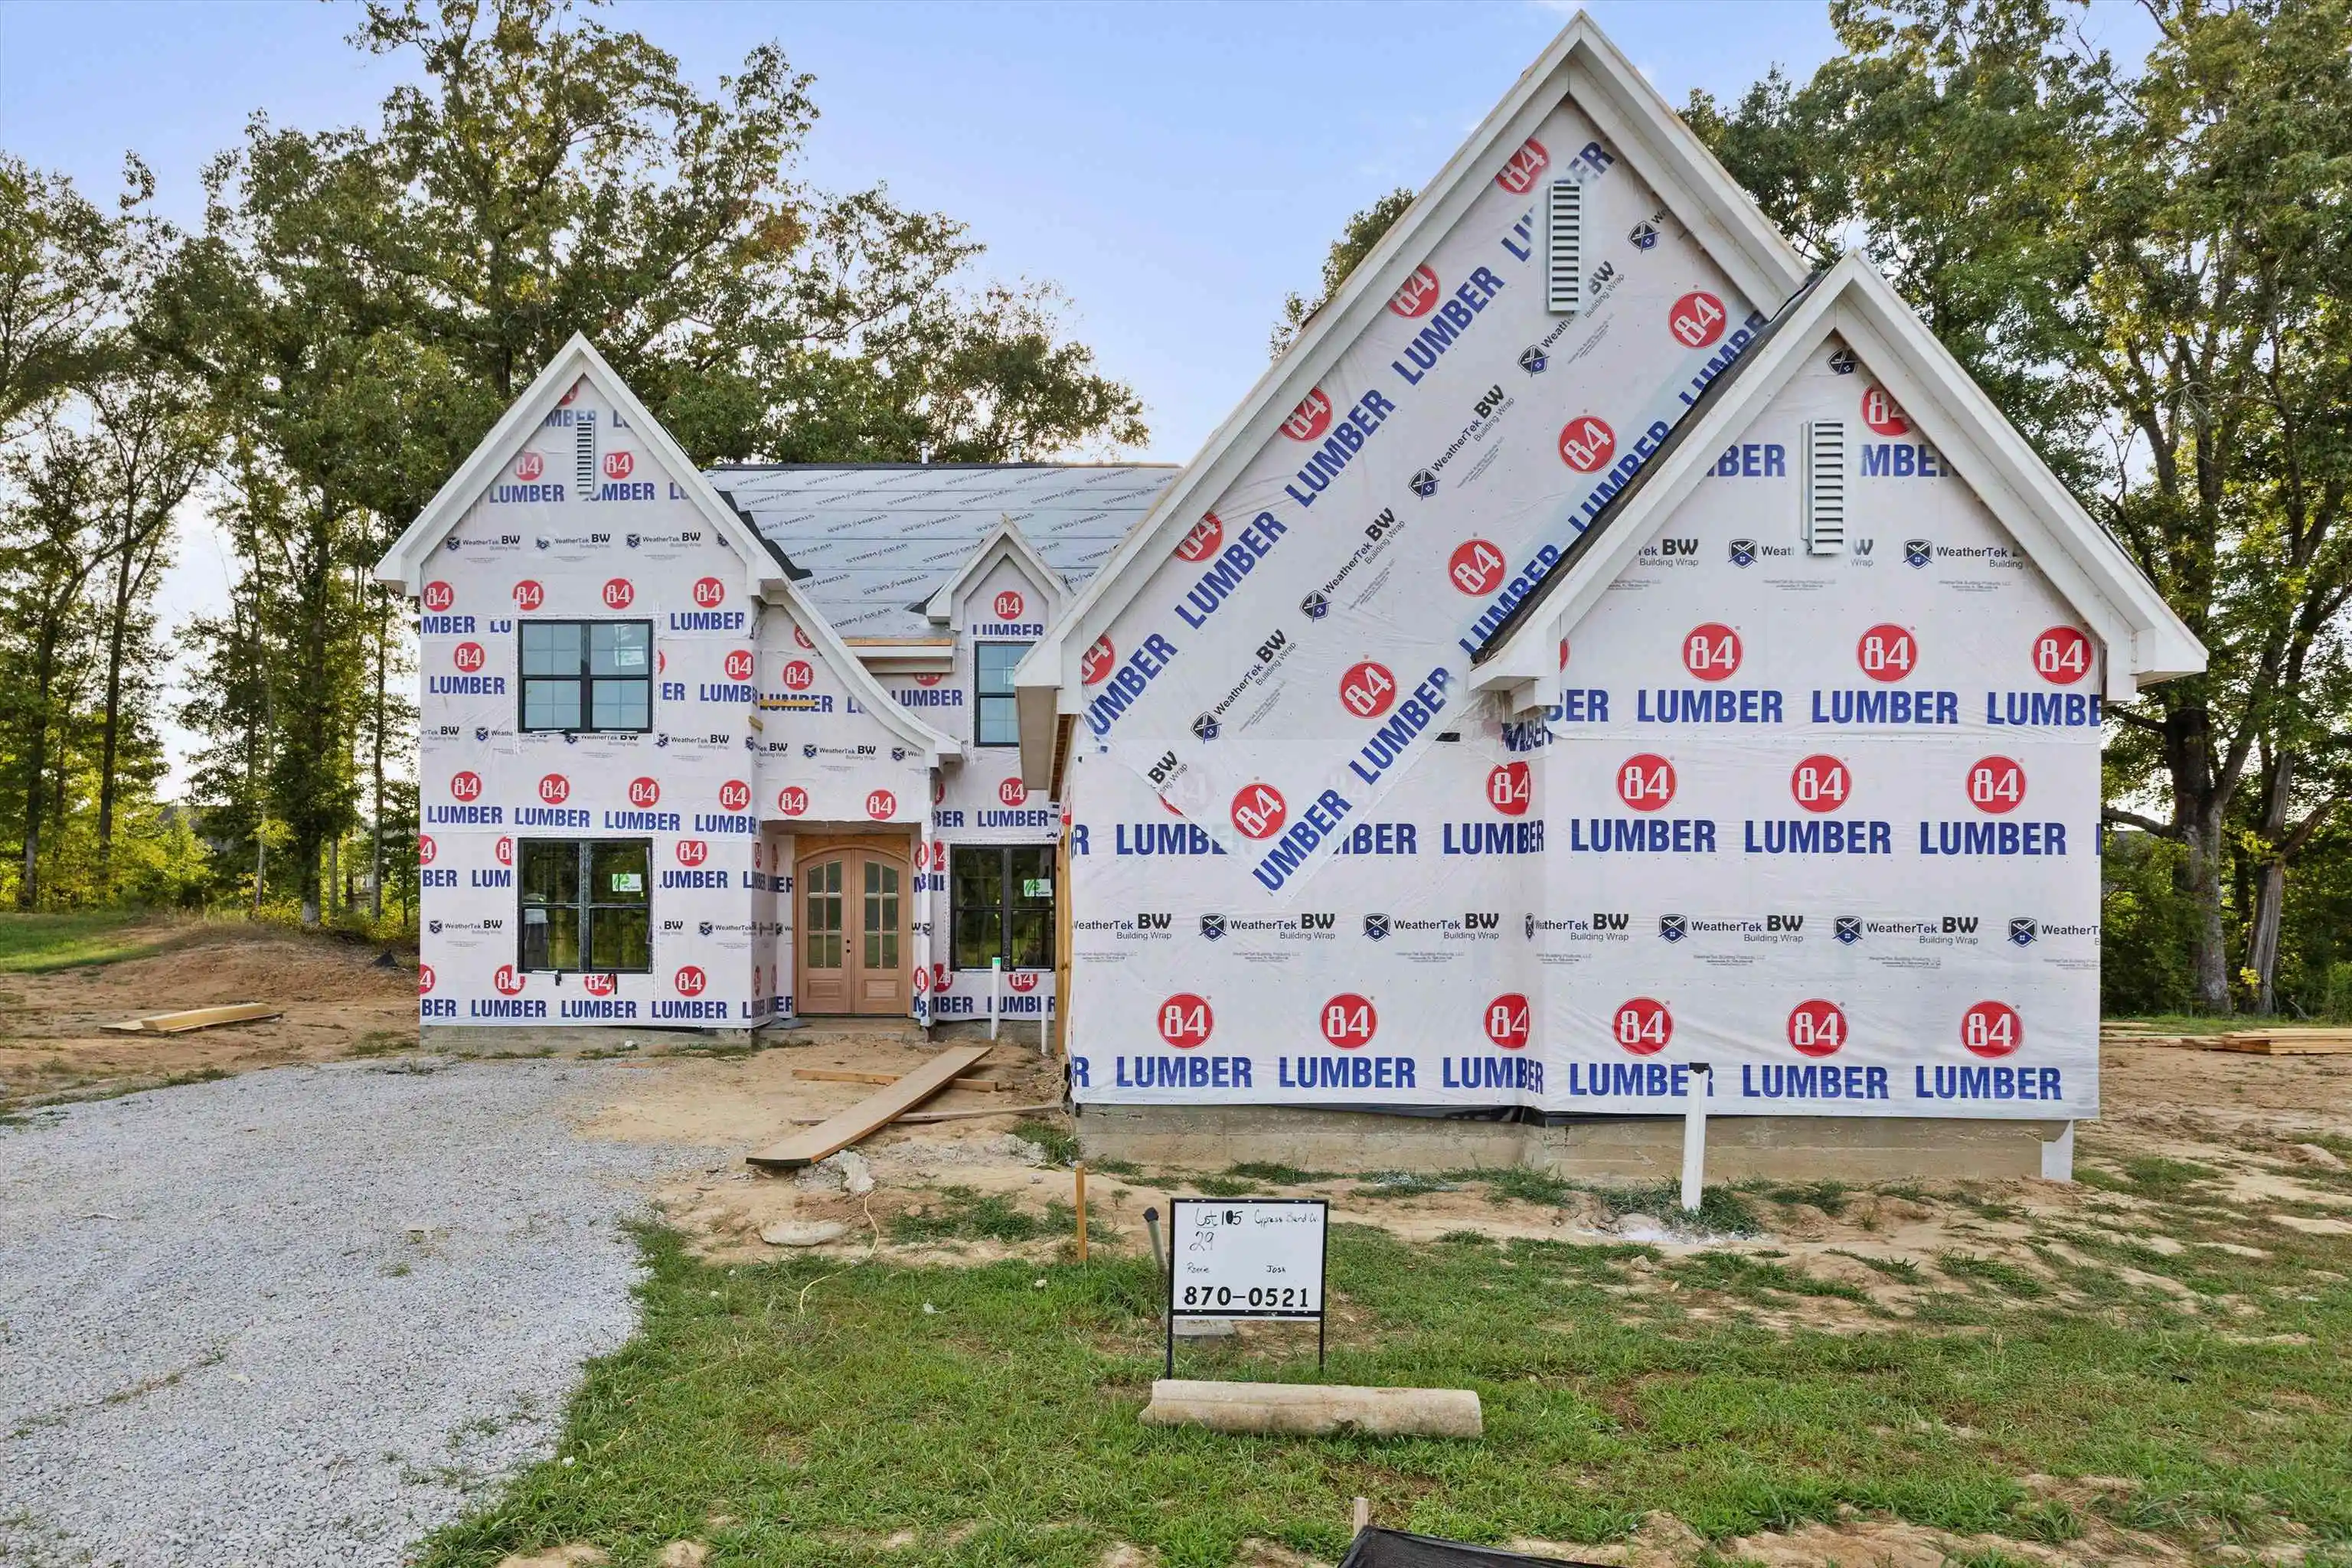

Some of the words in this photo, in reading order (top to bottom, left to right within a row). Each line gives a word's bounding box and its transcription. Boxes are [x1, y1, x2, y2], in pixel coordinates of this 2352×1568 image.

[1391, 266, 1505, 386] LUMBER
[1676, 298, 1722, 344] 84
[1432, 419, 1482, 472] WeatherTek
[1474, 384, 1504, 419] BW
[1473, 415, 1500, 442] Building
[1496, 397, 1514, 416] Wrap
[1285, 390, 1396, 508] LUMBER
[1565, 423, 1611, 468] 84
[516, 456, 541, 475] 84
[606, 453, 631, 473] 84
[488, 484, 565, 503] LUMBER
[501, 535, 521, 545] BW
[592, 534, 611, 543] BW
[681, 532, 701, 542] BW
[1364, 537, 1390, 564] Building
[1387, 520, 1406, 539] Wrap
[1662, 538, 1699, 556] BW
[845, 551, 877, 564] STORM
[884, 543, 908, 554] GEAR
[1323, 541, 1373, 594] WeatherTek
[1364, 507, 1395, 542] BW
[1936, 547, 2007, 558] WeatherTek
[1174, 511, 1288, 629] LUMBER
[1455, 545, 1501, 592] 84
[1639, 557, 1674, 567] Building
[1675, 558, 1699, 568] Wrap
[1989, 559, 2024, 570] Building
[426, 586, 451, 606] 84
[516, 586, 541, 605] 84
[606, 584, 631, 604] 84
[697, 583, 721, 603] 84
[997, 597, 1021, 615] 84
[423, 616, 475, 634] MBER
[831, 616, 858, 629] TORM
[457, 648, 482, 667] 84
[1690, 636, 1736, 670] 84
[1864, 637, 1910, 671] 84
[2040, 639, 2084, 674] 84
[728, 656, 753, 675] 84
[1214, 663, 1264, 716] WeatherTek
[1256, 629, 1287, 664] BW
[1256, 659, 1281, 686] Building
[1278, 642, 1297, 661] Wrap
[430, 676, 505, 694] LUMBER
[786, 666, 810, 685] 84
[1083, 633, 1178, 736] UMBER
[1346, 668, 1392, 714] 84
[1637, 690, 1782, 724] LUMBER
[1812, 691, 1958, 724] LUMBER
[1987, 692, 2102, 727] LUMBE
[441, 727, 460, 736] BW
[1348, 667, 1453, 785] LUMBER
[710, 734, 730, 743] BW
[769, 743, 788, 752] BW
[858, 746, 877, 755] BW
[1148, 750, 1178, 784] BW
[454, 777, 478, 796] 84
[542, 779, 566, 799] 84
[632, 783, 657, 802] 84
[1001, 783, 1025, 802] 84
[1494, 771, 1529, 805] 84
[1625, 766, 1670, 801] 84
[1798, 768, 1844, 802] 84
[1974, 769, 2019, 803] 84
[722, 786, 746, 805] 84
[781, 792, 804, 811] 84
[869, 795, 893, 815] 84
[427, 805, 503, 825] LUMBER
[514, 807, 590, 828] LUMBER
[604, 811, 681, 831] LUMBER
[978, 810, 1049, 828] LUMBER
[1237, 789, 1282, 835] 84
[1253, 789, 1353, 891] UMBER
[1443, 819, 1544, 855] LUMBER
[1571, 818, 1716, 852] LUMBER
[1745, 820, 1891, 854] LUMBER
[1920, 822, 2066, 855] LUMBER
[679, 841, 704, 861] 84
[423, 870, 457, 887] BER
[472, 870, 511, 887] LUM
[659, 871, 727, 889] UMBER
[483, 920, 503, 929] BW
[664, 920, 683, 930] BW
[1137, 913, 1172, 929] BW
[1230, 920, 1297, 930] WeatherTek
[1301, 913, 1335, 929] BW
[1394, 920, 1461, 930] WeatherTek
[1465, 913, 1499, 929] BW
[1592, 913, 1629, 930] BW
[1690, 921, 1762, 932] WeatherTek
[1766, 915, 1804, 932] BW
[1867, 923, 1937, 933] WeatherTek
[1942, 916, 1978, 933] BW
[2041, 925, 2100, 936] WeatherT
[1116, 932, 1148, 941] Building
[1149, 932, 1172, 940] Wrap
[1279, 932, 1312, 941] Building
[1313, 932, 1335, 940] Wrap
[1443, 932, 1475, 941] Building
[1477, 932, 1499, 940] Wrap
[1570, 932, 1604, 942] Building
[1607, 933, 1629, 942] Wrap
[1743, 933, 1778, 943] Building
[1780, 934, 1804, 943] Wrap
[1919, 936, 1952, 946] Building
[1955, 936, 1978, 946] Wrap
[678, 972, 703, 991] 84
[422, 999, 456, 1017] BER
[471, 999, 547, 1018] LUMBER
[561, 1000, 637, 1019] LUMBER
[652, 1001, 727, 1019] LUMBER
[1165, 1005, 1207, 1038] 84
[1328, 1006, 1370, 1038] 84
[1491, 1006, 1528, 1038] 84
[1621, 1011, 1667, 1044] 84
[1795, 1012, 1840, 1047] 84
[1968, 1014, 2014, 1047] 84
[1116, 1057, 1252, 1088] LUMBER
[1279, 1057, 1416, 1089] LUMBER
[1442, 1057, 1544, 1095] LUMBER
[1743, 1064, 1889, 1099] LUMBER
[1916, 1065, 2062, 1100] LUMBER
[1195, 1207, 1217, 1227] Lot
[1254, 1208, 1283, 1229] Cypress
[1188, 1230, 1215, 1251] 29
[1266, 1265, 1286, 1274] Josh
[1184, 1286, 1308, 1308] 870-0521
